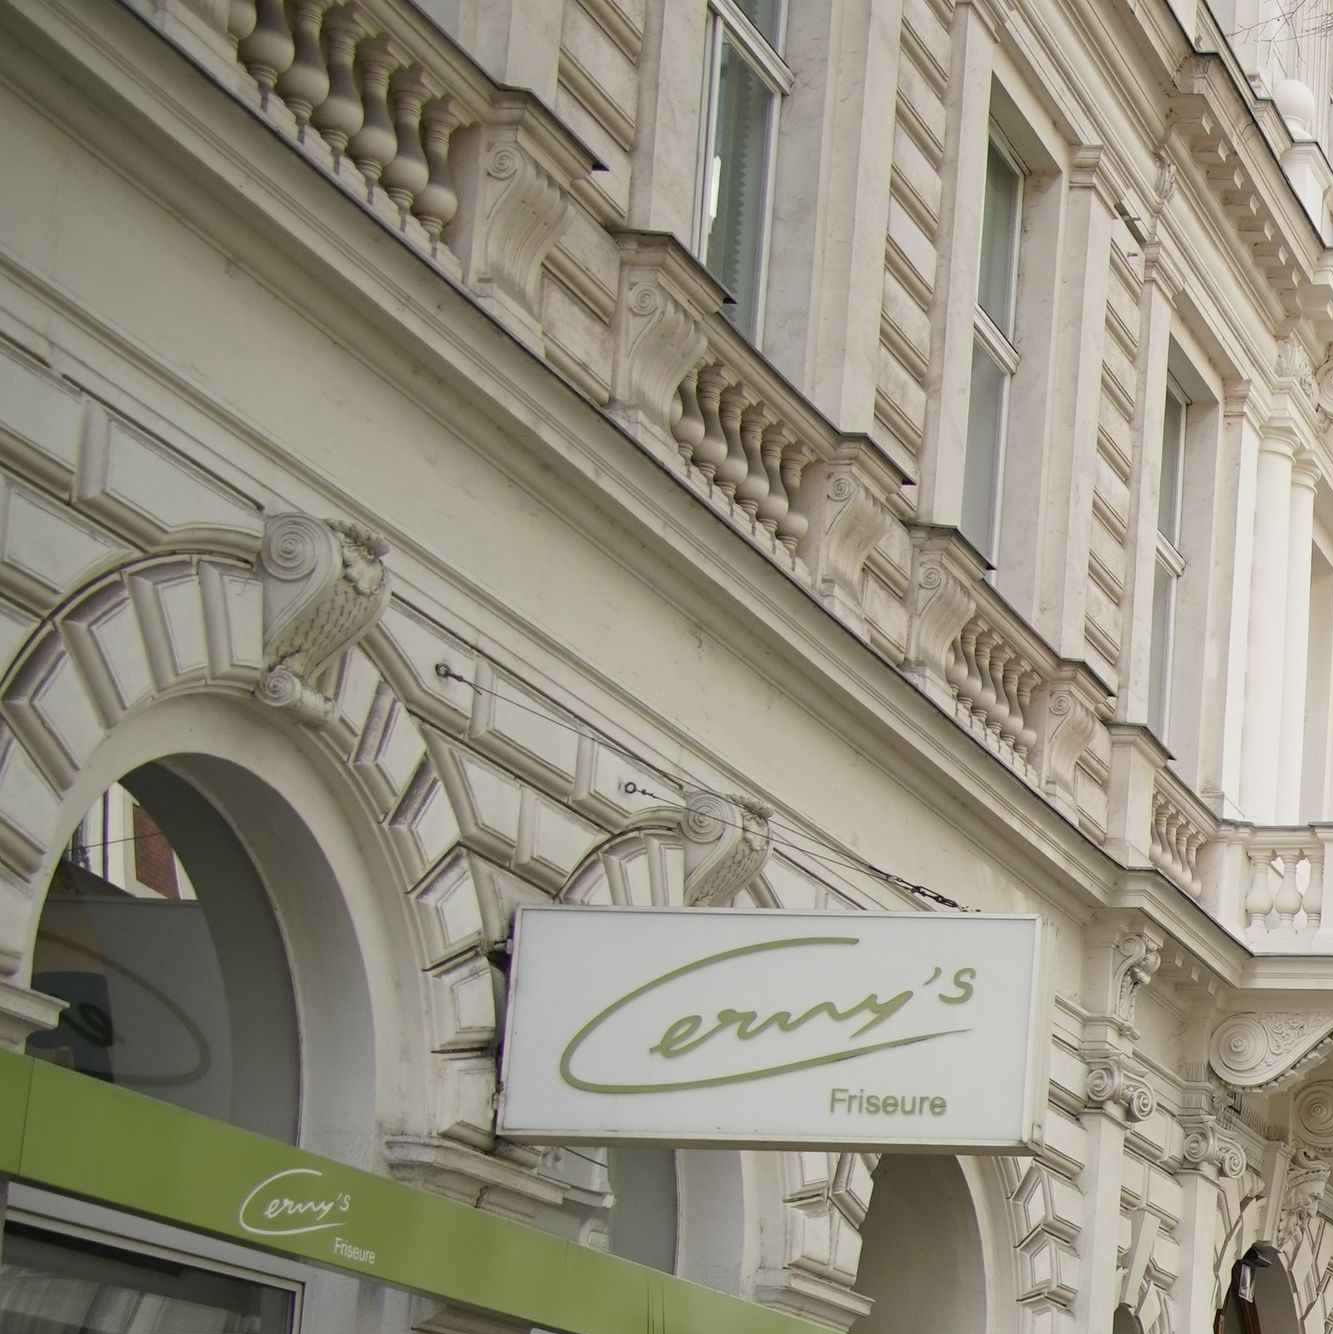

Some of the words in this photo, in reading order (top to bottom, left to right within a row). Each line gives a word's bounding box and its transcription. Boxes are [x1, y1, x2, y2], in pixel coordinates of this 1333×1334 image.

[560, 937, 976, 1094] Cerny's
[830, 1088, 947, 1116] Friseure
[240, 1168, 351, 1235] Cerny's
[334, 1237, 376, 1264] Friseure
